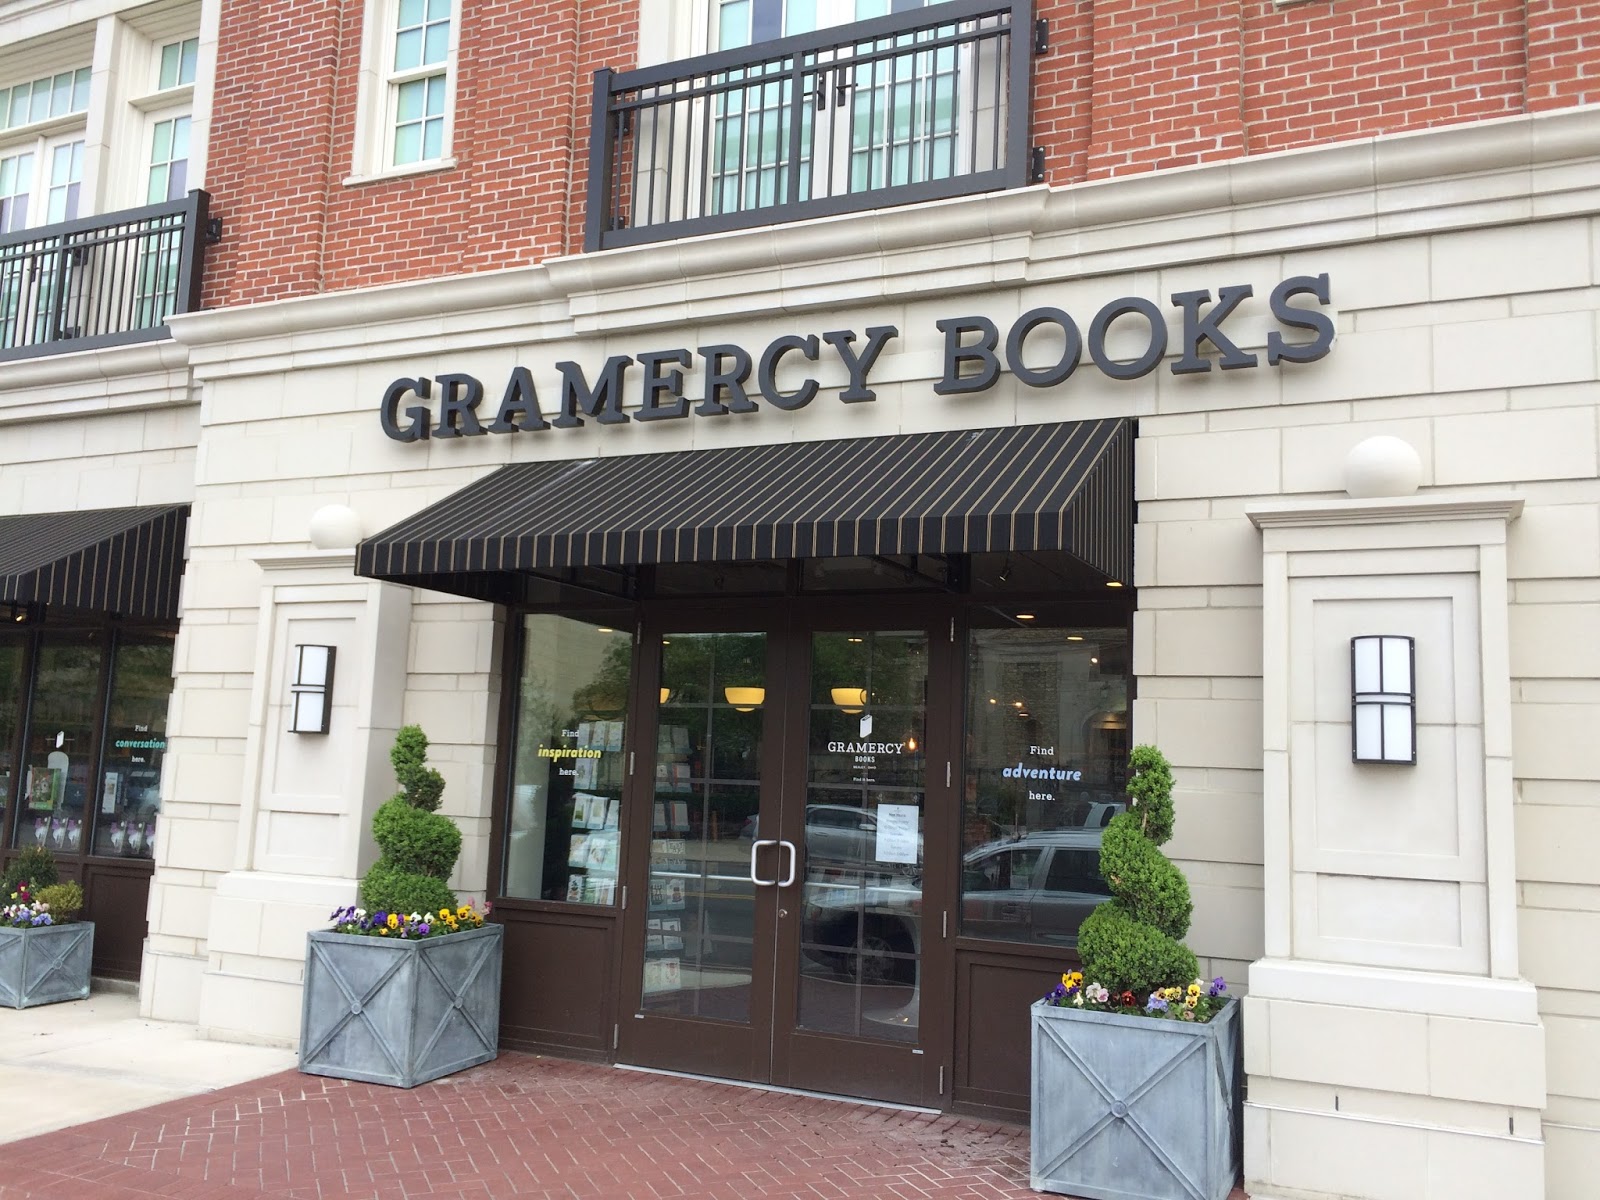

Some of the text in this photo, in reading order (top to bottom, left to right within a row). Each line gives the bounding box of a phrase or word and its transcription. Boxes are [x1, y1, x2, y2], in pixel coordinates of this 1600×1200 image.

[381, 273, 1335, 443] GRAMERCY BOOKS
[134, 724, 148, 732] Find
[561, 729, 580, 738] Find
[115, 738, 166, 748] conversation
[828, 741, 904, 754] GRAMERCY
[538, 744, 602, 762] inspiration
[1029, 745, 1055, 756] Find
[854, 755, 876, 763] BOOKS
[559, 767, 580, 776] here.
[1002, 762, 1082, 781] adventure
[1028, 790, 1056, 801] here.
